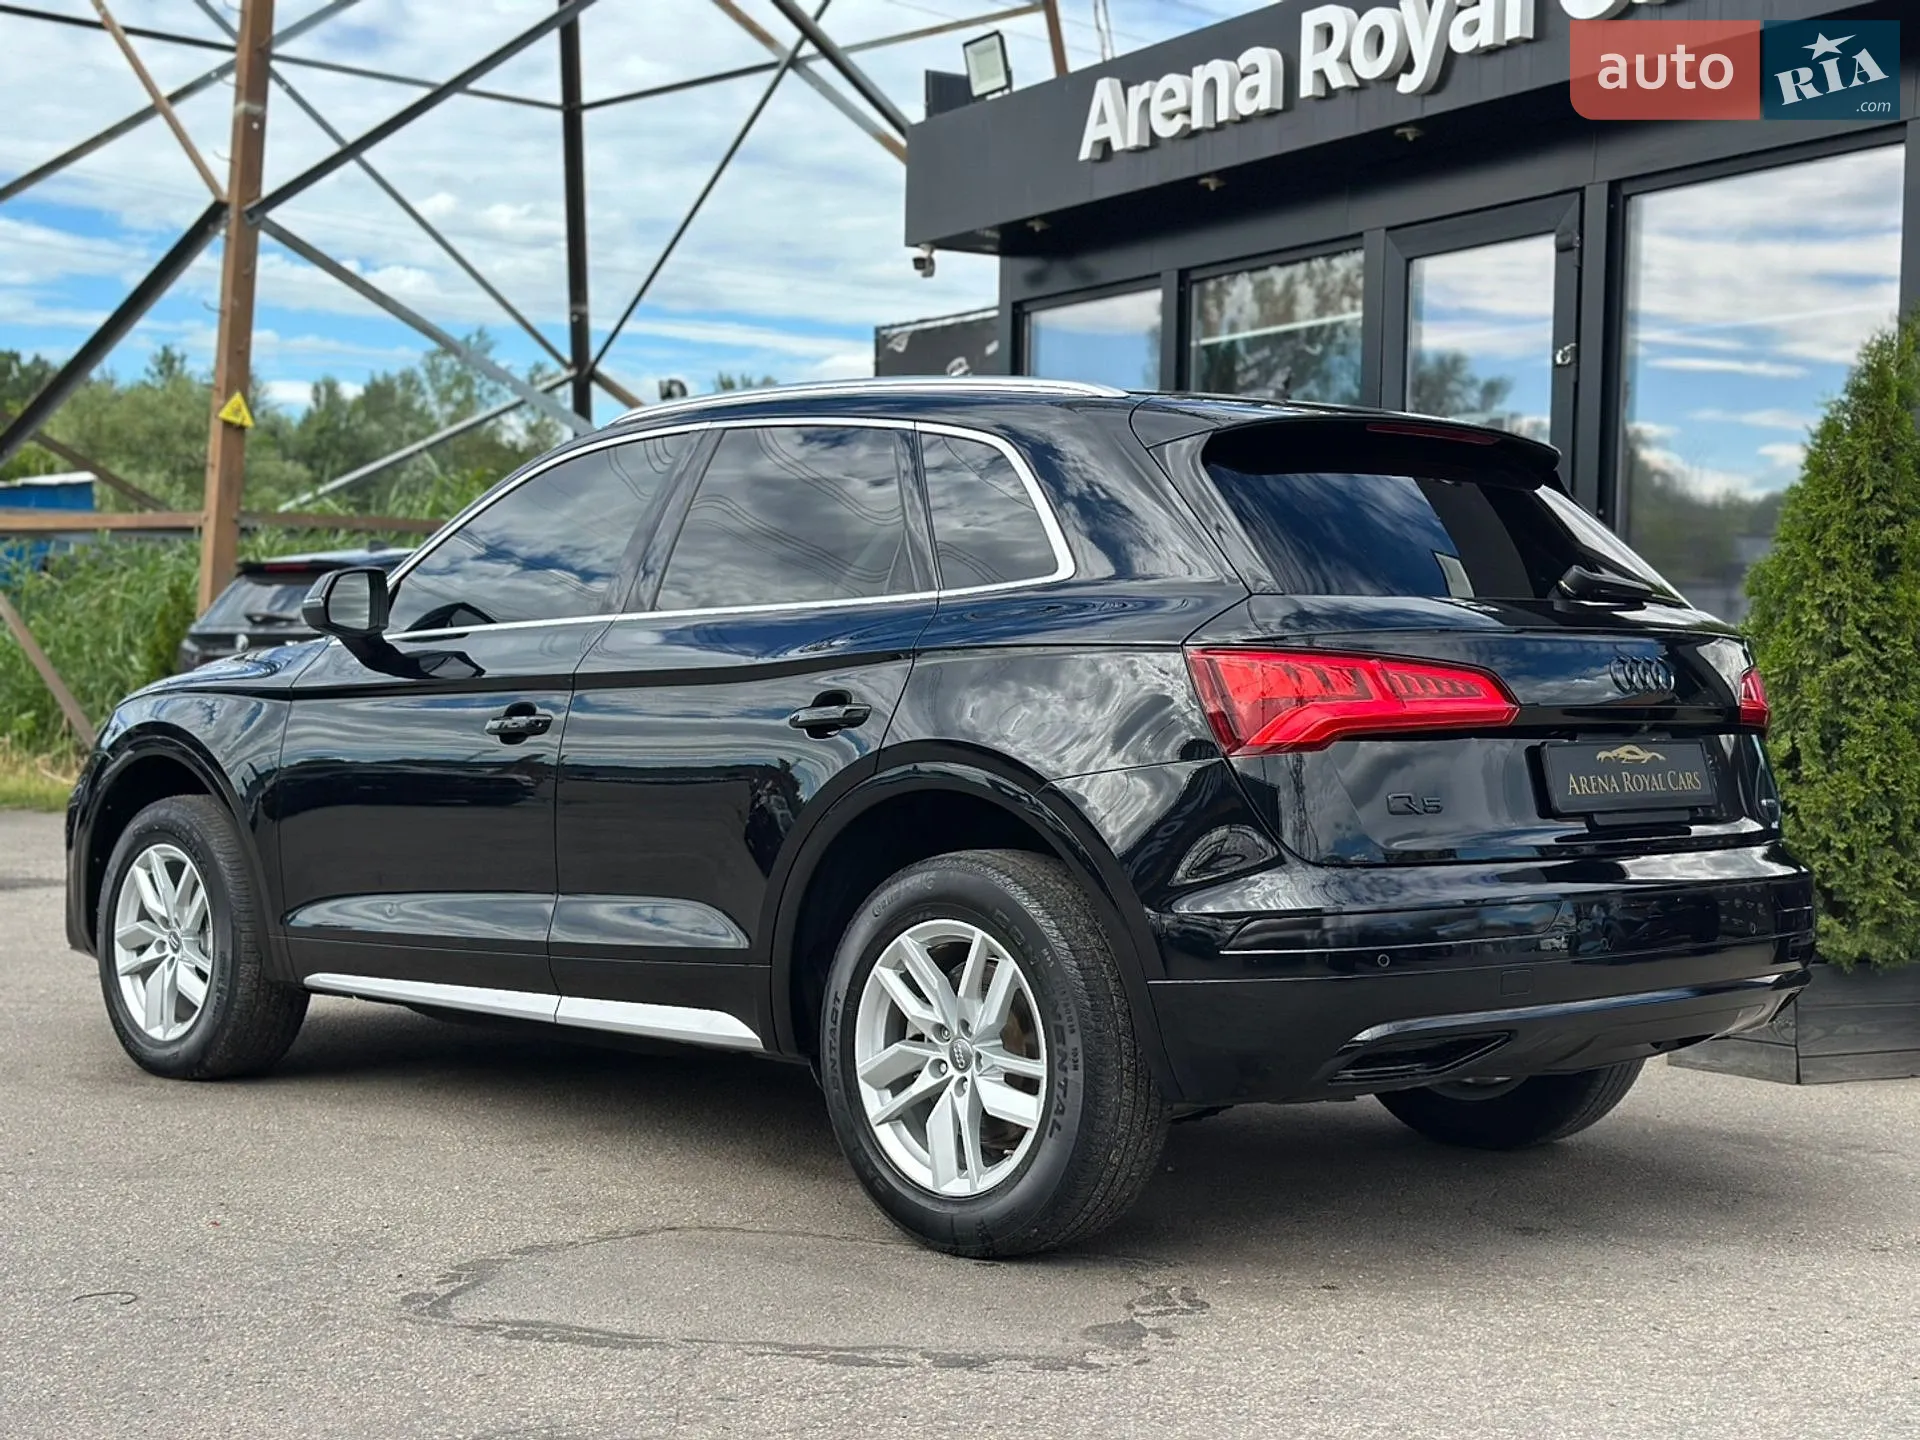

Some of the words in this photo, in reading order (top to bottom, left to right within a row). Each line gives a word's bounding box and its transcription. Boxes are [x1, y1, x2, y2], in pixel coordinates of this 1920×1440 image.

[1078, 46, 1285, 161] Arena
[1568, 772, 1620, 796] ARENA
[1621, 771, 1667, 793] ROYAL
[1667, 770, 1702, 791] CARS
[1386, 793, 1444, 816] Q5
